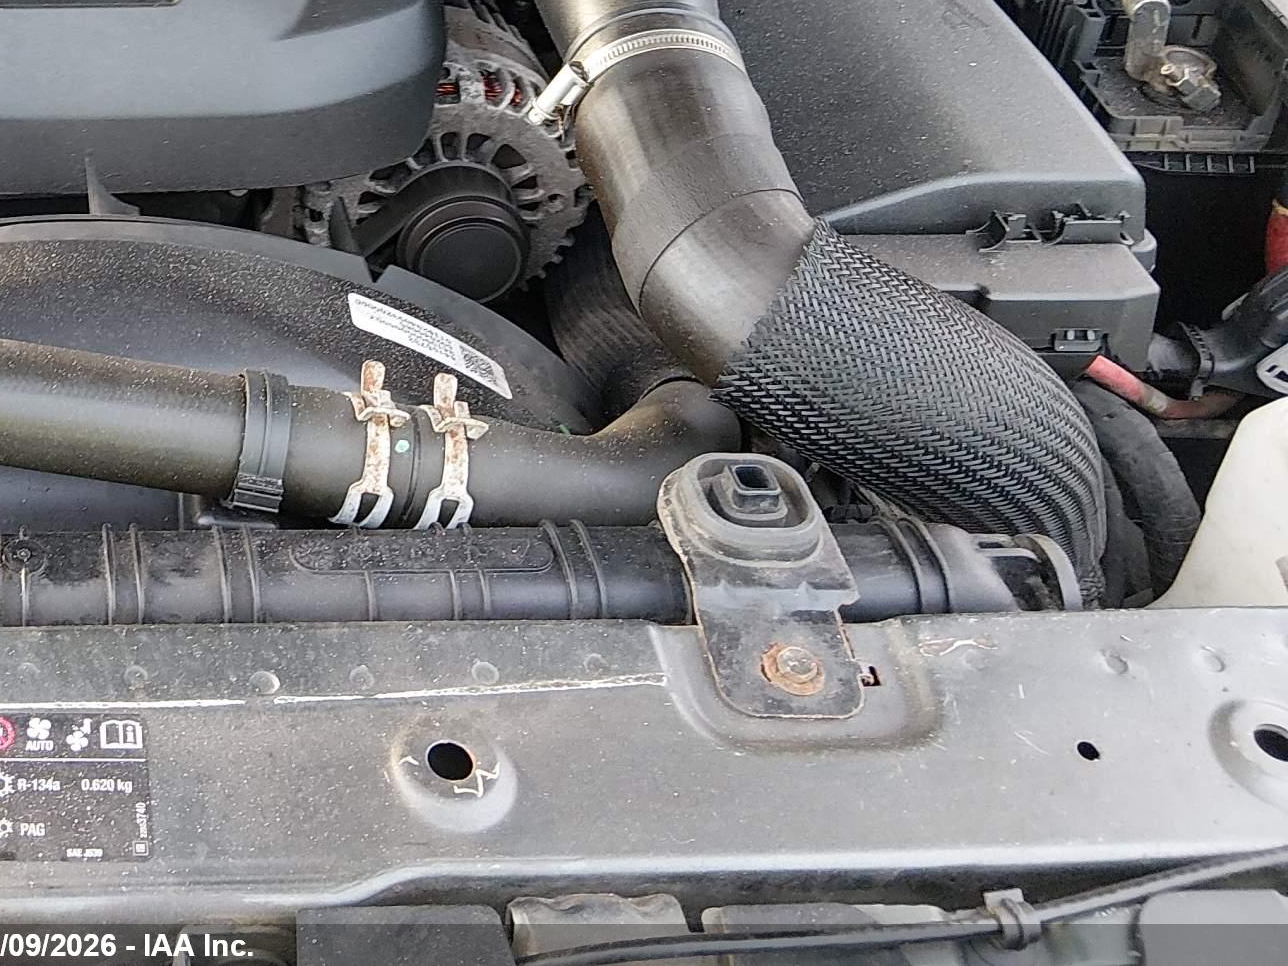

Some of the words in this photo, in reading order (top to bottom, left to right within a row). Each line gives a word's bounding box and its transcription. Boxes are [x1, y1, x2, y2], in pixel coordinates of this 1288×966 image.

[25, 740, 53, 751] AUTO
[17, 778, 60, 791] R-134a
[81, 778, 114, 791] 0.620
[117, 778, 133, 793] kg
[20, 822, 45, 836] PAG
